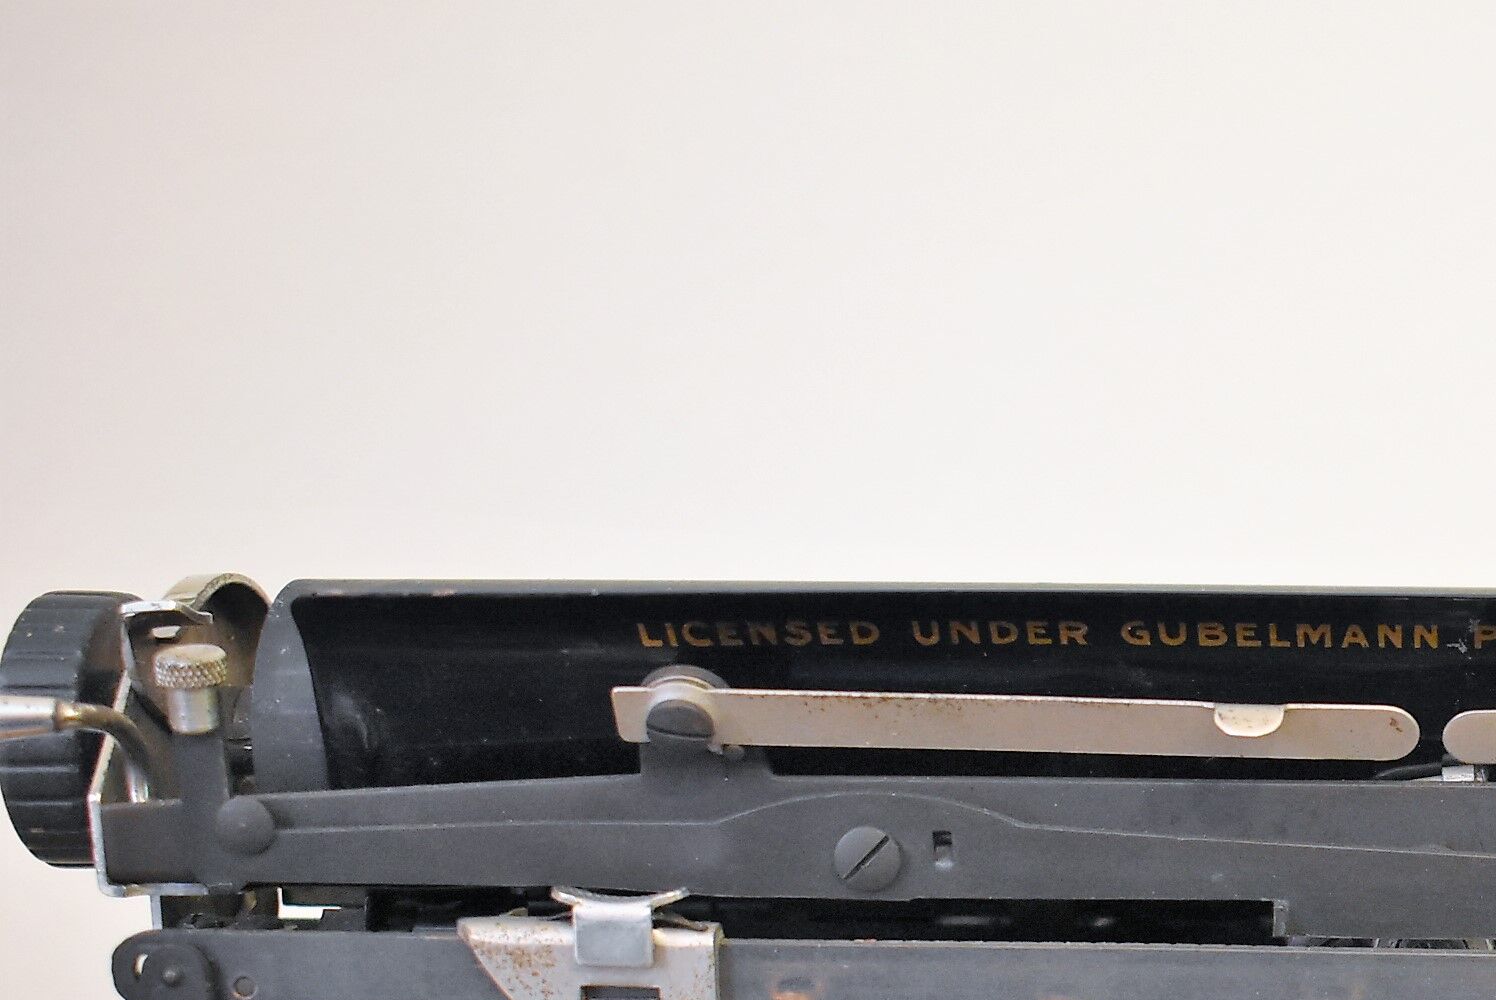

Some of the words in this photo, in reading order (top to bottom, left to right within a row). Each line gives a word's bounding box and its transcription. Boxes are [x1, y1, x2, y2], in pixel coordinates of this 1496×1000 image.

[637, 621, 879, 647] LICENSED
[911, 621, 1088, 646] UNDER
[1120, 621, 1453, 649] GUBELMANN
